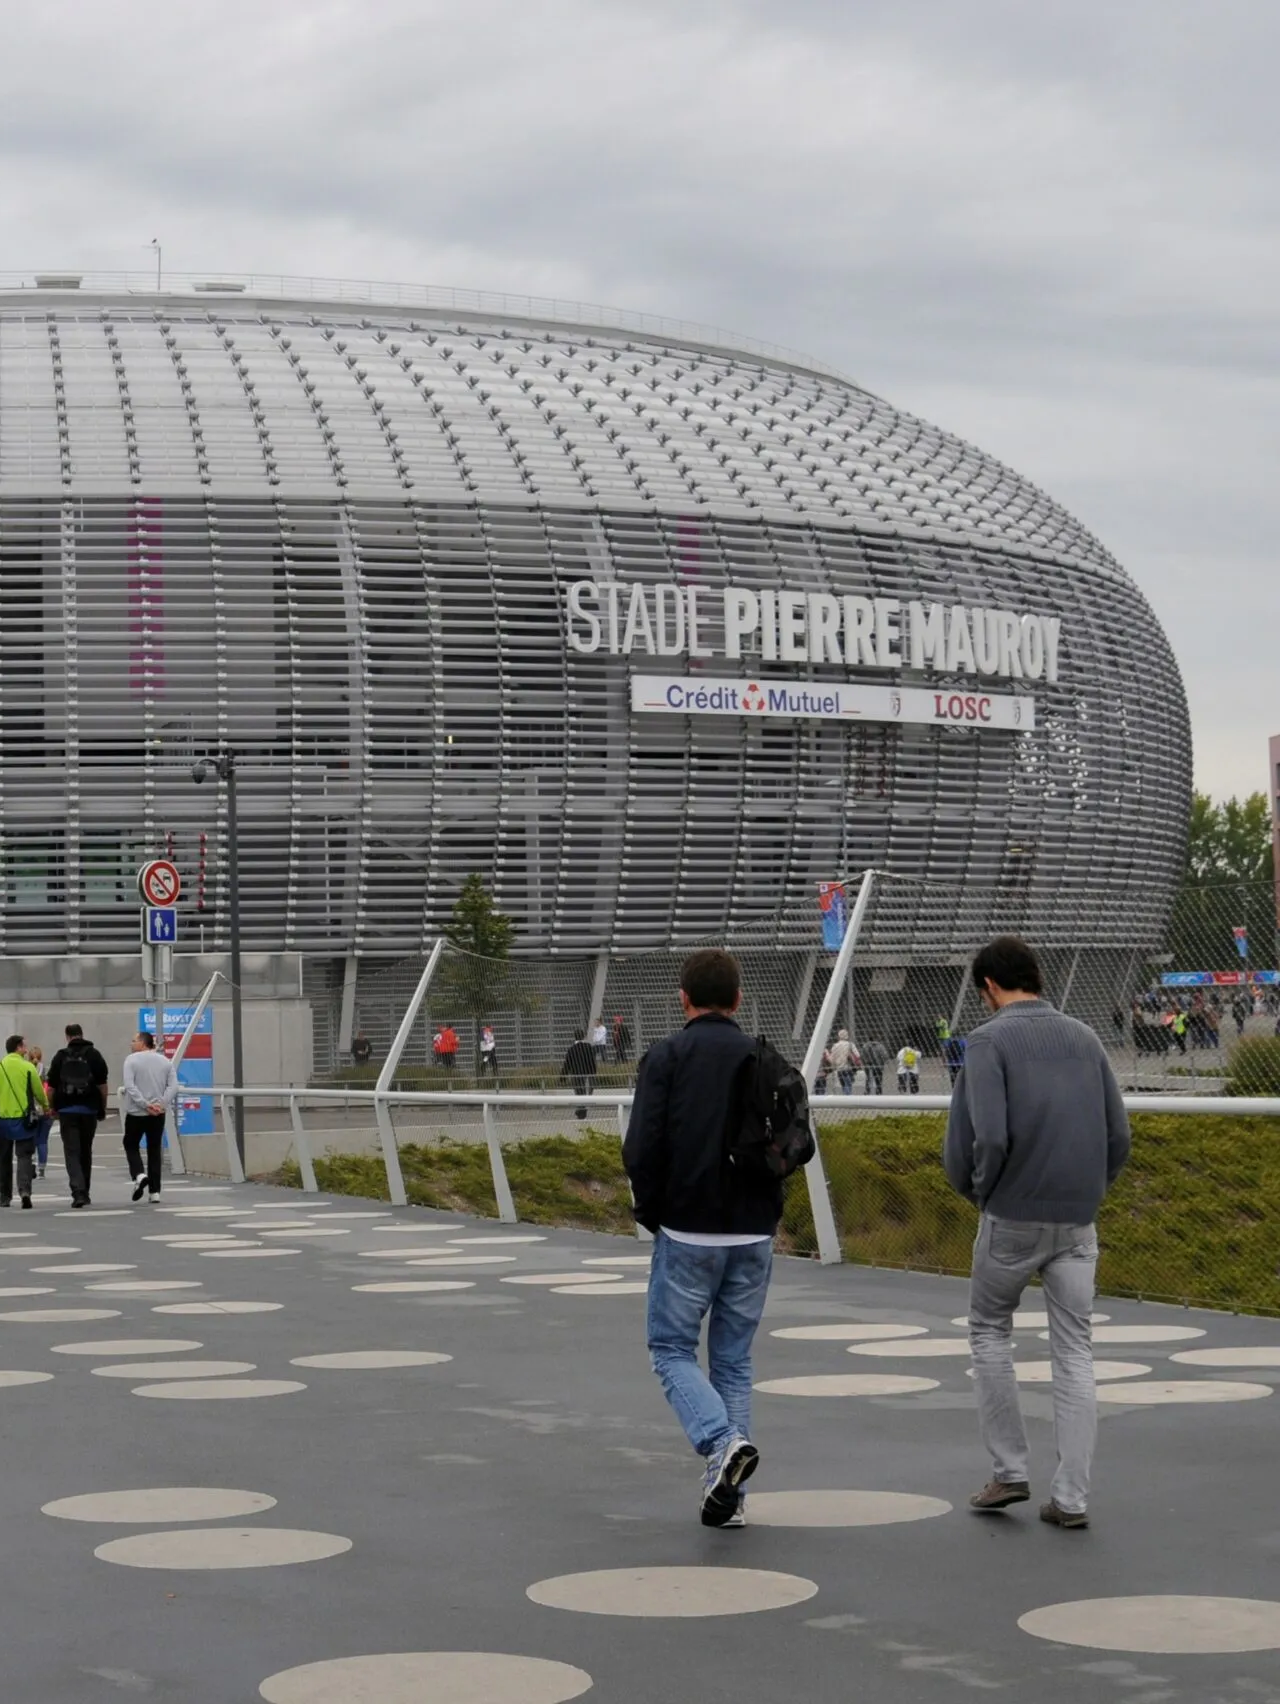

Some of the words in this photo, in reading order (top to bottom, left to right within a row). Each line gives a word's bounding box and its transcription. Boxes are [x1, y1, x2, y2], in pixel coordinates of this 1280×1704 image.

[567, 580, 713, 656] STADE
[724, 586, 901, 668] PIERRE
[909, 600, 1061, 682] MAUROY
[666, 684, 738, 710] Crédit
[767, 688, 840, 714] Mutuel
[933, 694, 992, 722] LOSC
